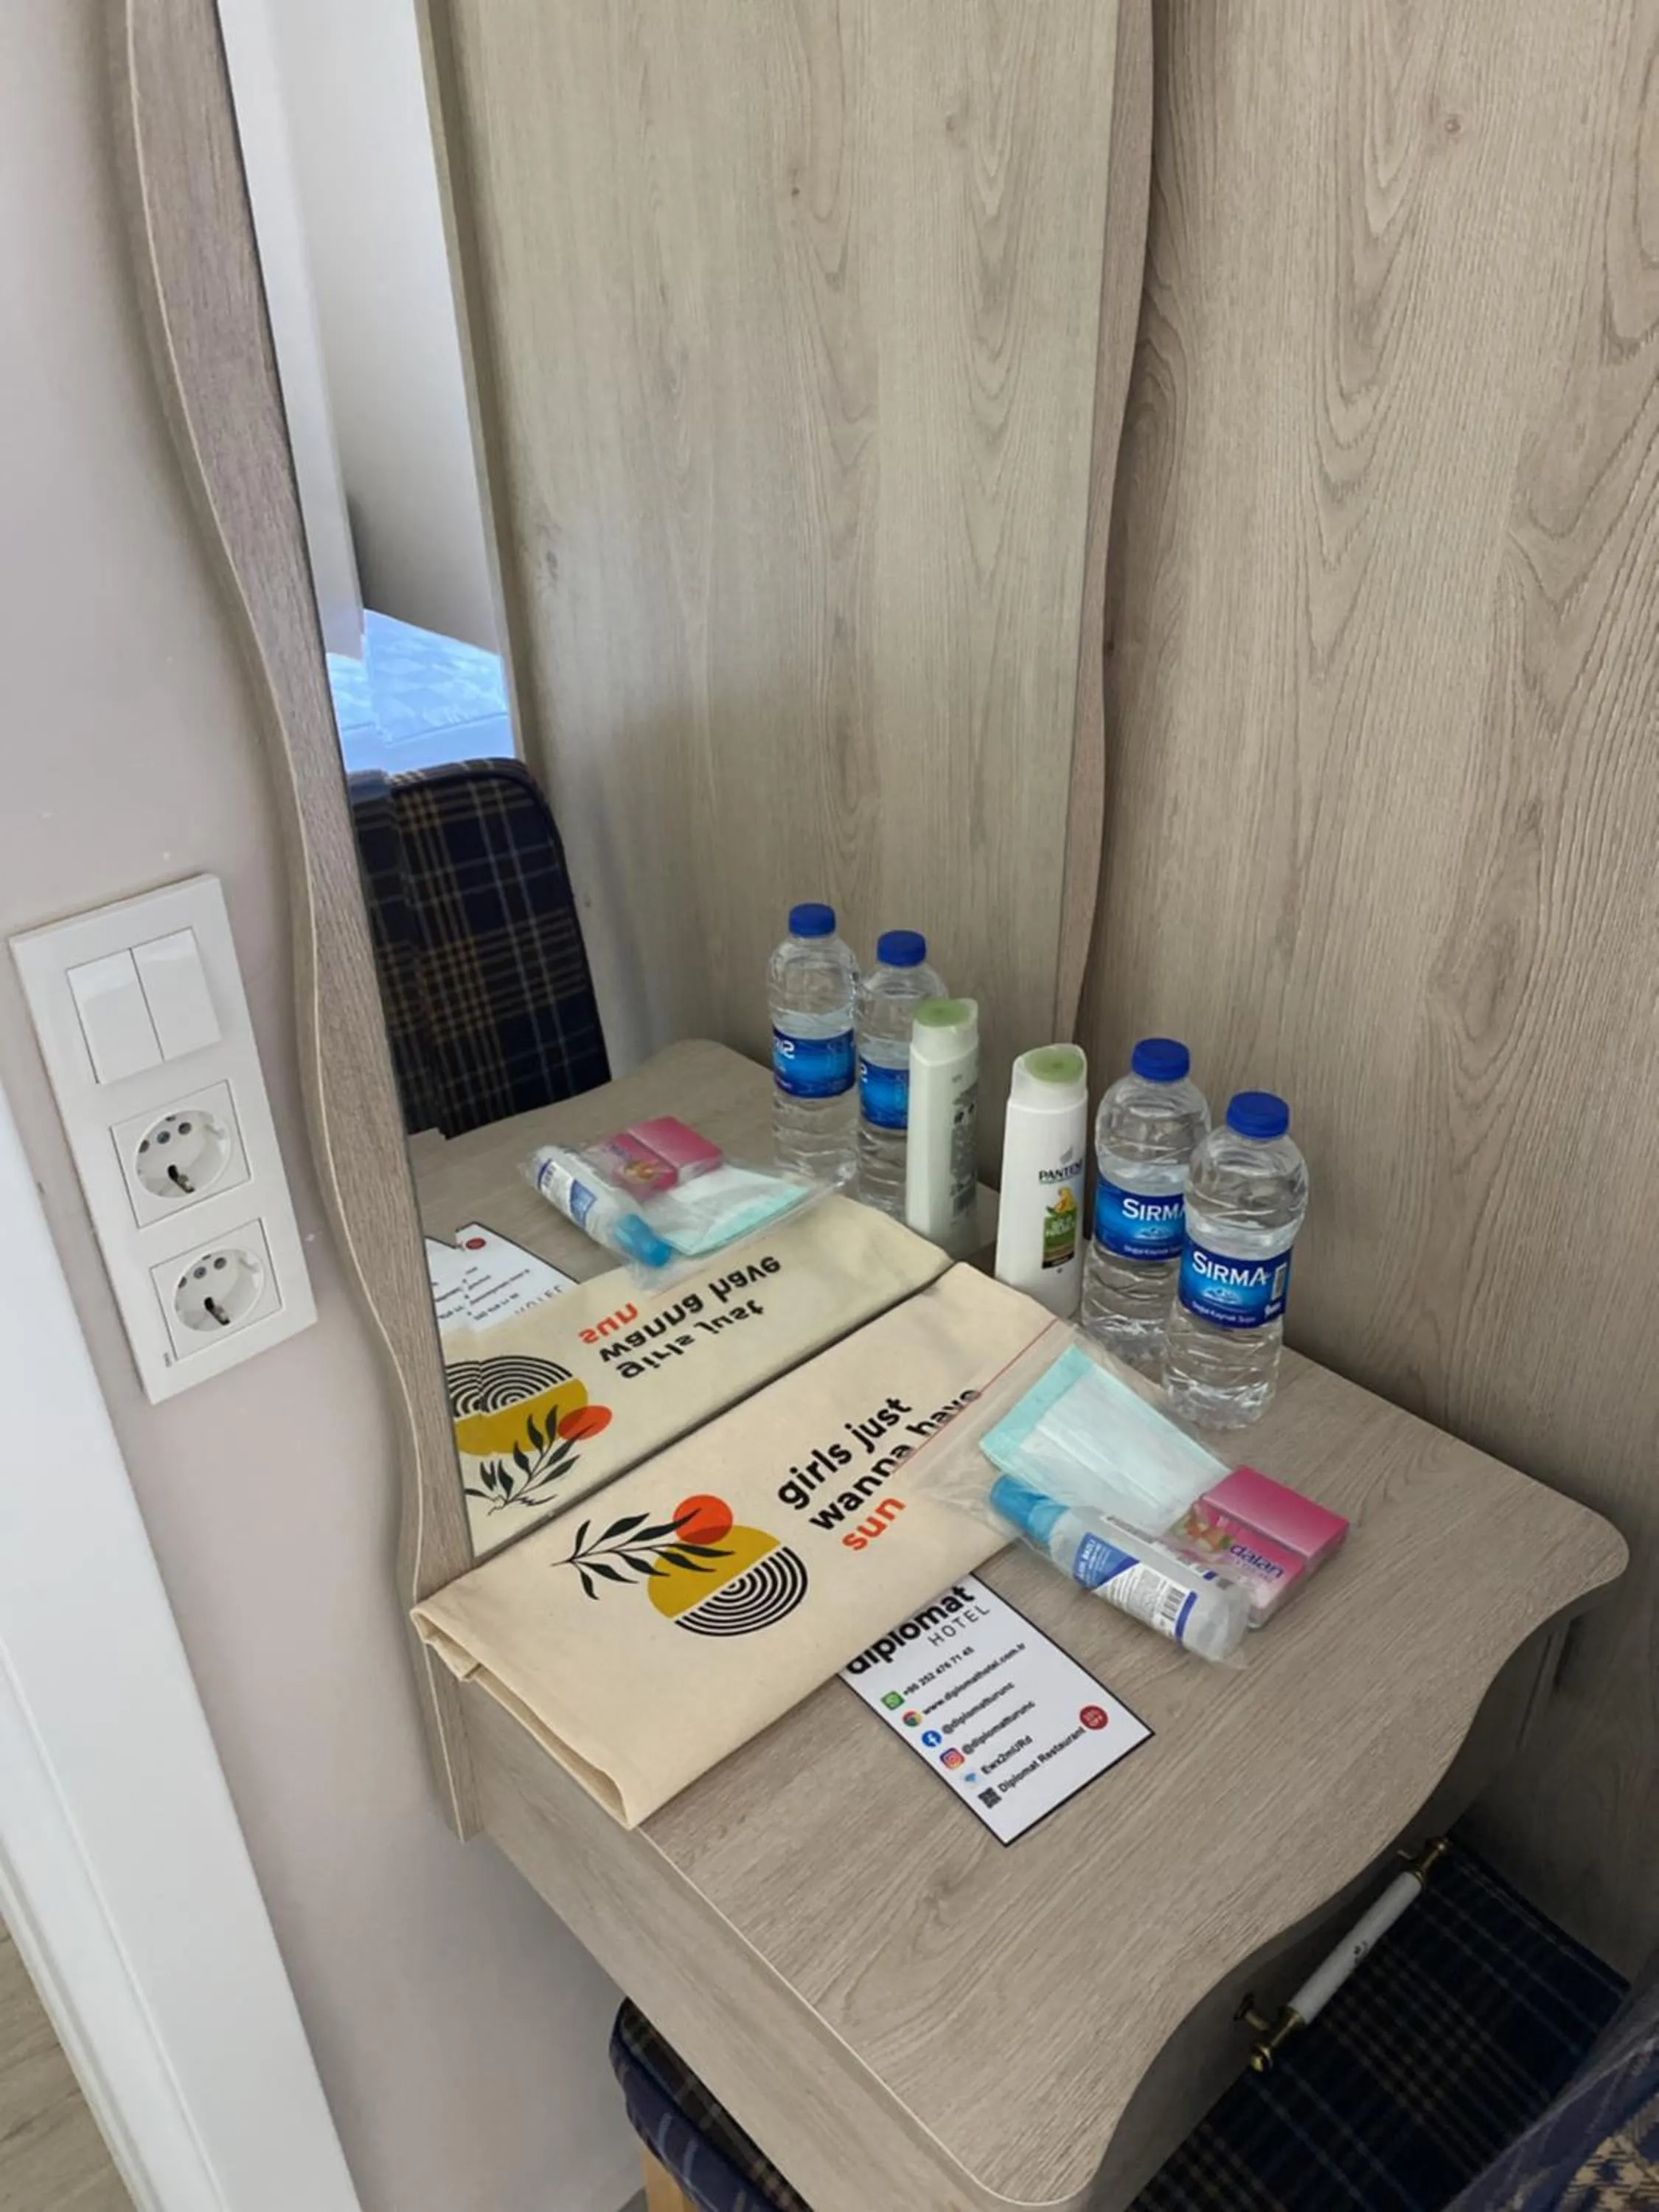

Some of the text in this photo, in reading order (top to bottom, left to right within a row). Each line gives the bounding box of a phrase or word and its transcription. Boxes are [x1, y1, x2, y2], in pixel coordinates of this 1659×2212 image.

[1038, 1158, 1083, 1180] PANTEN
[1192, 1251, 1267, 1287] SIRMA
[778, 1398, 913, 1510] girls just
[809, 1444, 917, 1531] wanna
[842, 1498, 907, 1551] sun
[927, 1604, 990, 1646] HOTEL
[998, 1726, 1086, 1792] Diplomat Restaurant
